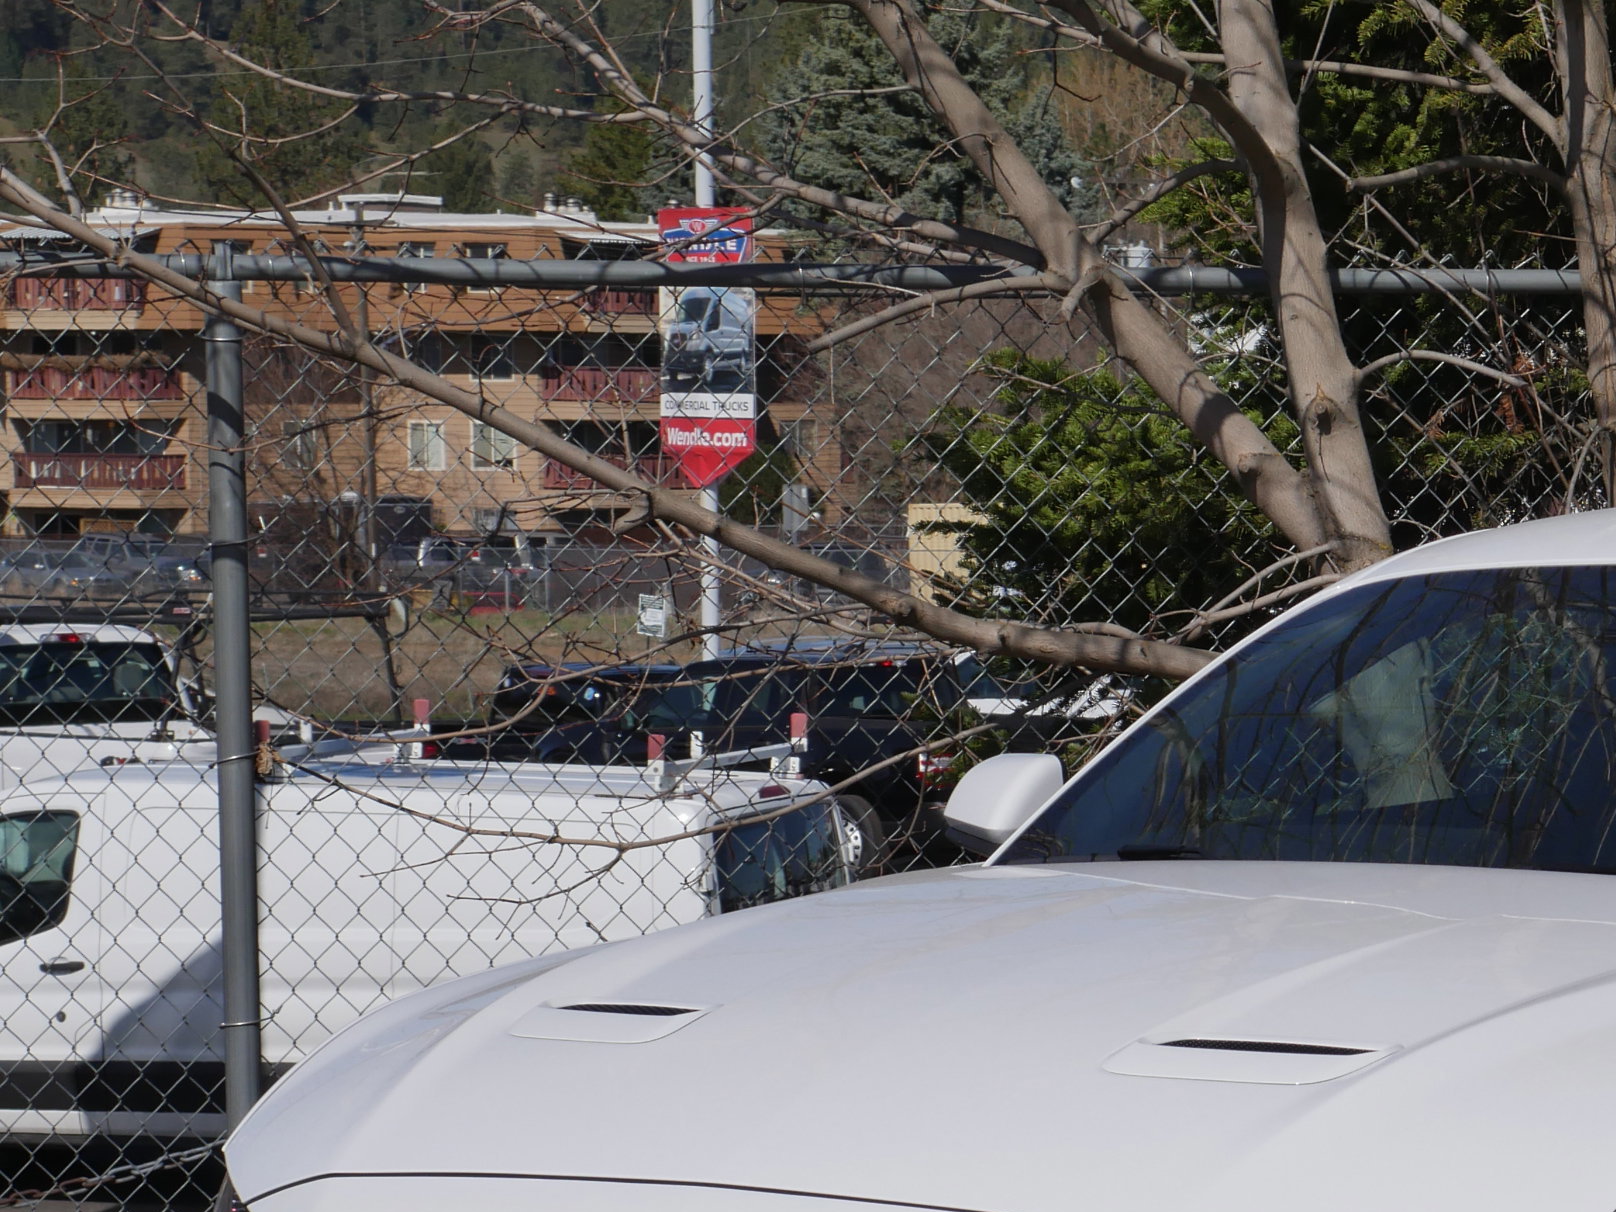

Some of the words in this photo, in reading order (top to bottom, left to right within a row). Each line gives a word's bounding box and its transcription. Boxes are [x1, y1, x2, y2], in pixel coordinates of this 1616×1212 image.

[666, 237, 737, 251] NDLE
[665, 400, 710, 411] COERCIAL
[667, 427, 748, 447] Wendle.com
